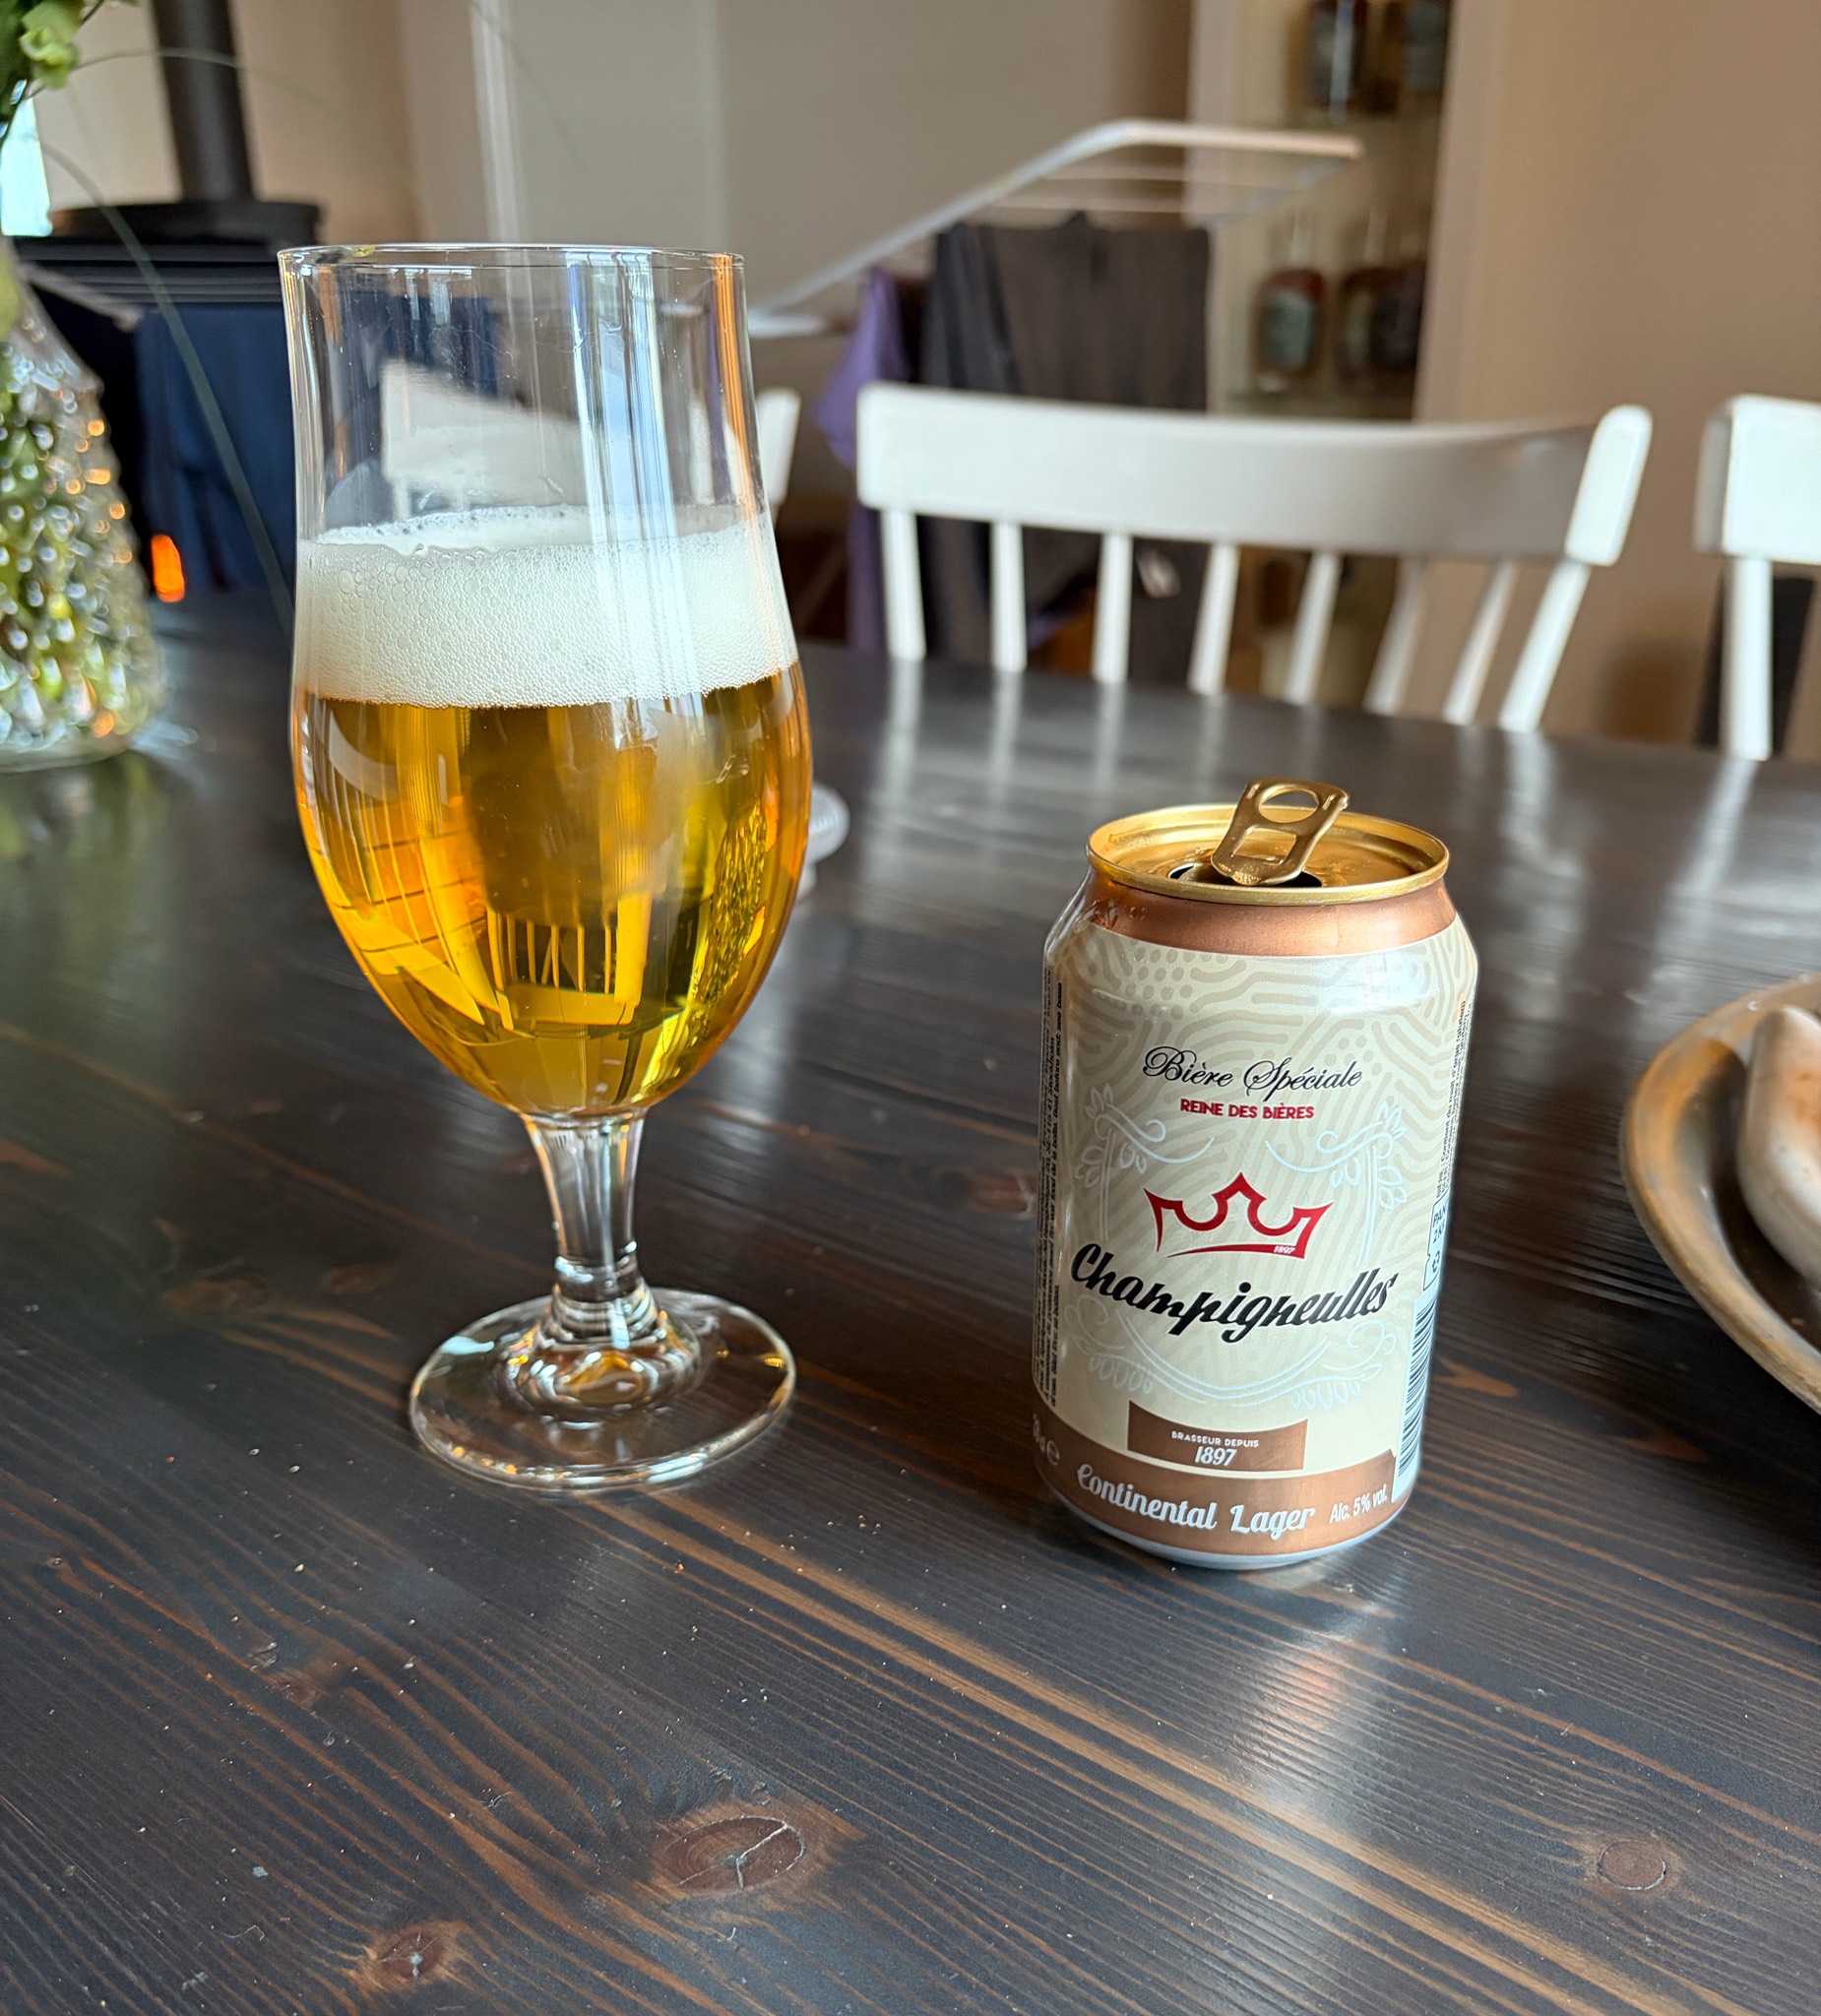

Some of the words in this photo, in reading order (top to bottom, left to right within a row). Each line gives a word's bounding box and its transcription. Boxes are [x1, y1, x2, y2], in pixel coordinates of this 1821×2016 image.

[1143, 1045, 1233, 1087] Bière
[1243, 1056, 1362, 1102] Spéciale
[1180, 1099, 1224, 1116] REINE
[1228, 1103, 1258, 1118] DES
[1262, 1102, 1315, 1119] BIÈRES
[1440, 1120, 1451, 1162] Contient
[1451, 1043, 1461, 1078] d'orge
[1273, 1244, 1296, 1255] 1897
[1071, 1243, 1399, 1344] Champigneulles
[1171, 1430, 1222, 1446] BRASSEUR
[1224, 1438, 1260, 1448] DEPUIS
[1194, 1445, 1237, 1467] 1897
[1077, 1464, 1218, 1531] Continental
[1229, 1504, 1316, 1541] Lager
[1329, 1502, 1350, 1524] Alc.
[1352, 1492, 1371, 1517] 5%
[1372, 1483, 1388, 1508] vol.
